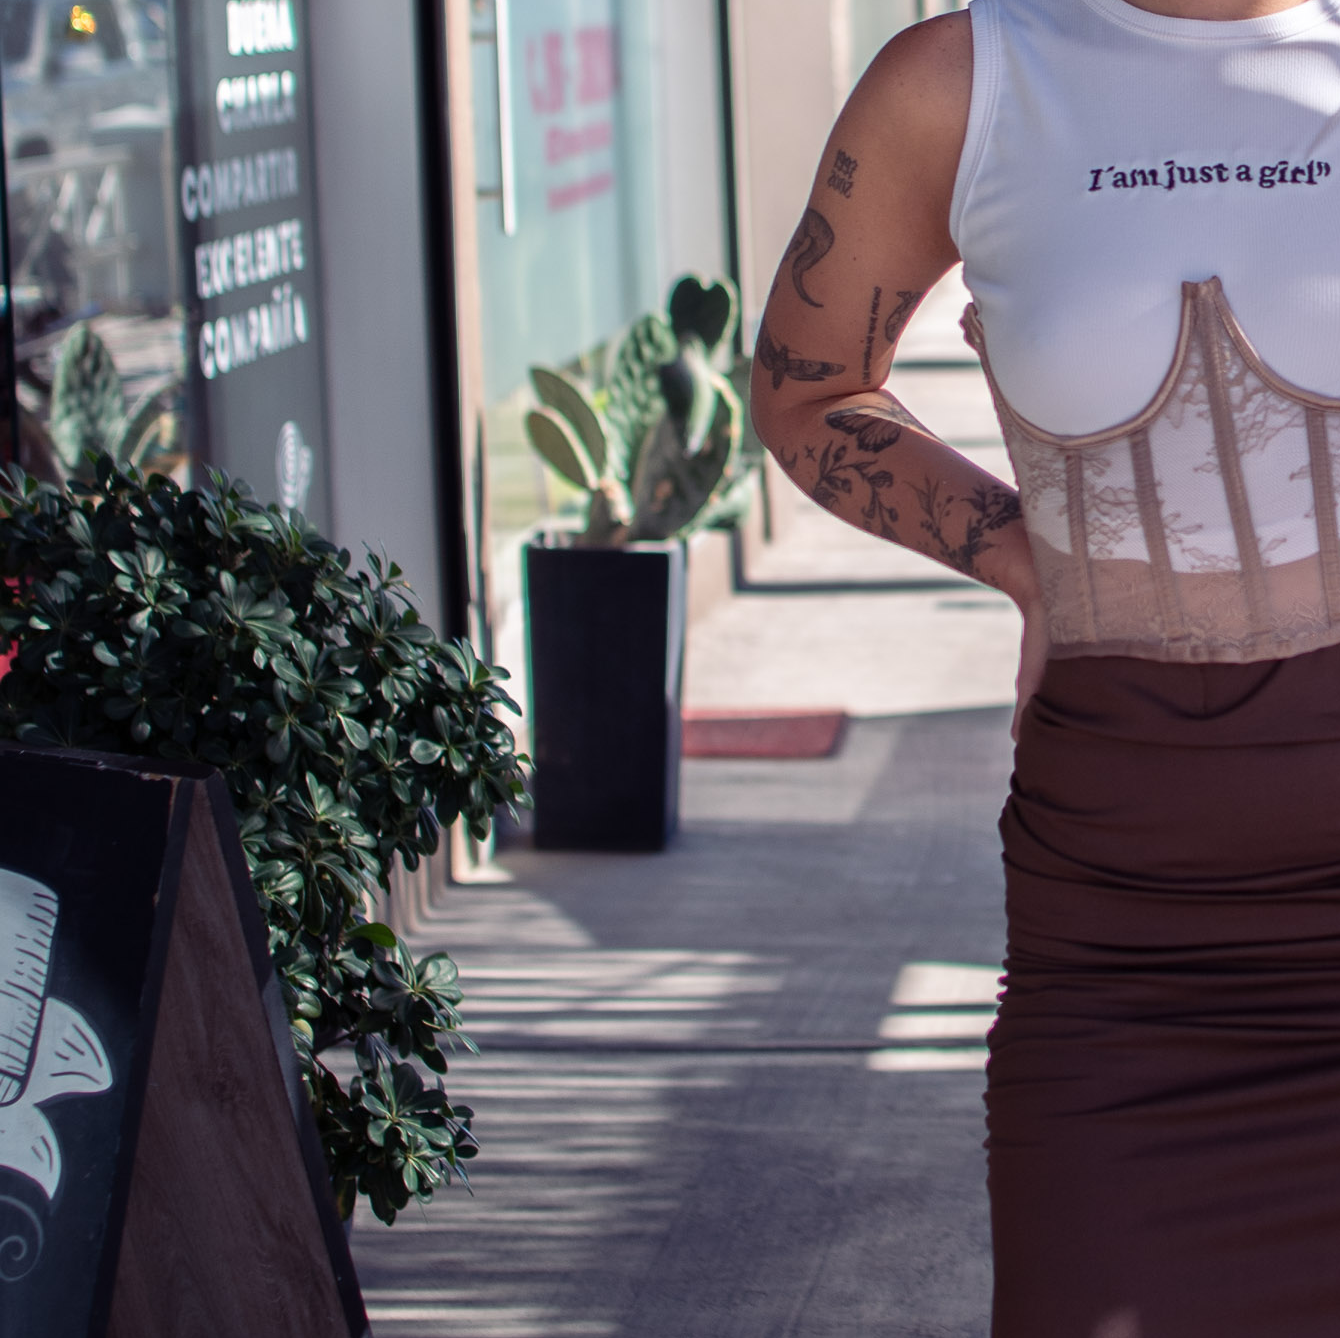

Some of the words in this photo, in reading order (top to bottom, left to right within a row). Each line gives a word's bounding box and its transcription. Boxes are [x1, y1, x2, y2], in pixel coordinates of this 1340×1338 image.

[181, 147, 298, 222] COMPARTIR
[1163, 160, 1230, 192] just
[1235, 163, 1254, 184] a
[195, 219, 304, 299] EXCELENTE
